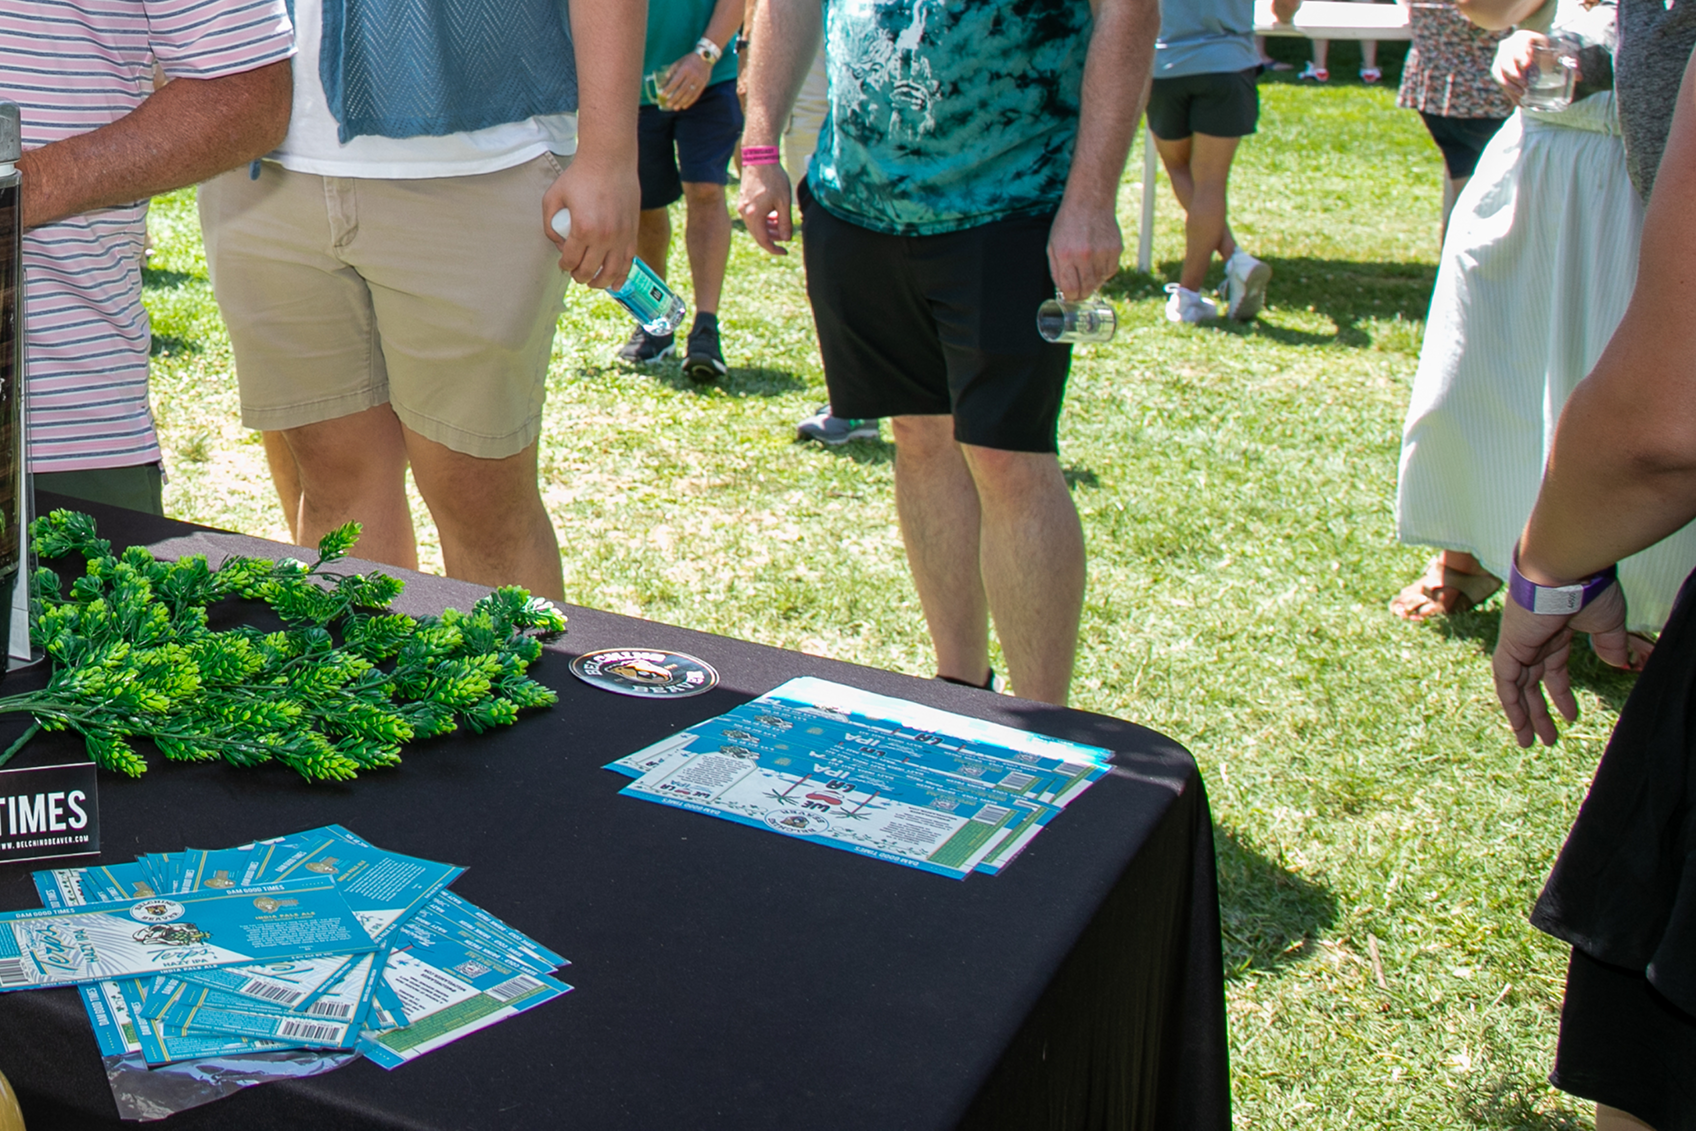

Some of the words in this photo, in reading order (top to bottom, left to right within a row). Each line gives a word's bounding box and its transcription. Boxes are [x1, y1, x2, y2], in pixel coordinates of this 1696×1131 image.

[844, 732, 881, 747] IPA
[812, 763, 851, 779] IPA
[825, 780, 855, 794] LA
[801, 800, 830, 813] WE
[854, 846, 878, 857] TIMES
[879, 852, 900, 862] GOOD
[901, 857, 920, 867] DAM
[243, 886, 261, 894] GOOD
[262, 884, 285, 892] TIMES
[53, 907, 76, 915] TIMES
[162, 959, 190, 967] HAZY
[505, 959, 520, 968] COLD
